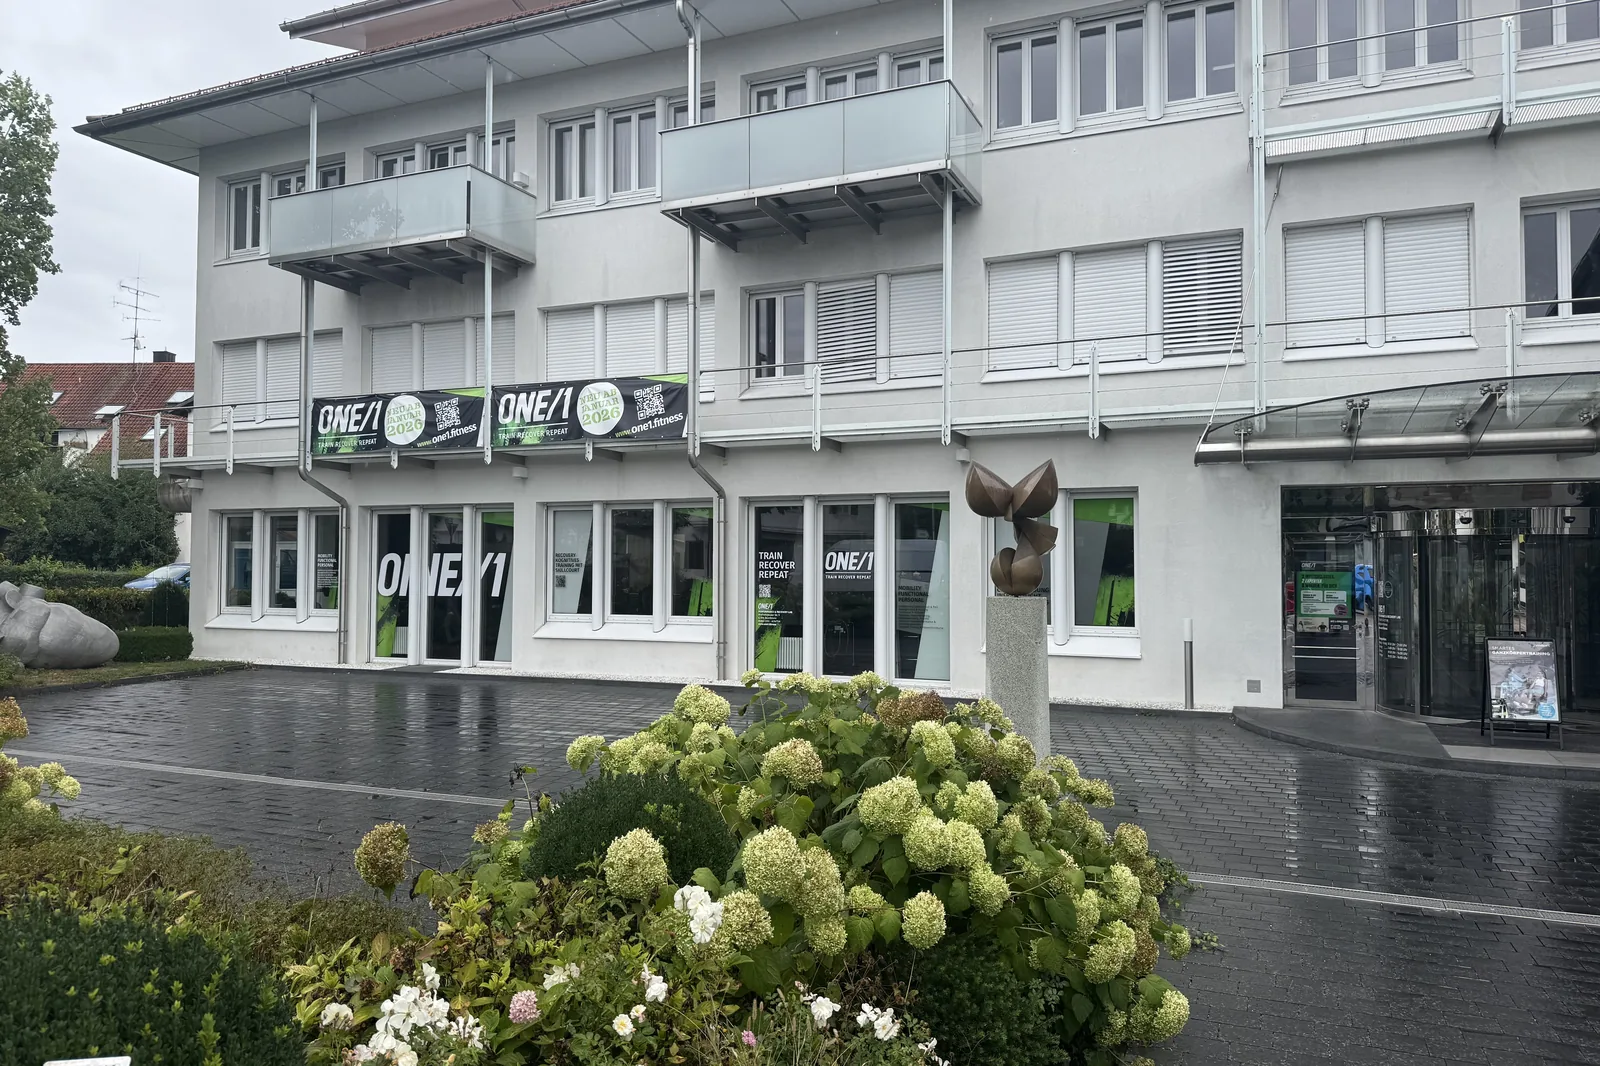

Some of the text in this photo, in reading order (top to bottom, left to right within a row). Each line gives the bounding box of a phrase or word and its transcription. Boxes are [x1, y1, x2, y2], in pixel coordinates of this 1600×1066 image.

[580, 388, 617, 405] NEU AB
[387, 402, 422, 418] NEU AB
[498, 387, 573, 424] ONE/1
[582, 397, 620, 413] JANUAR
[318, 400, 383, 434] ONE/1
[387, 410, 422, 424] JANUAR
[582, 407, 621, 426] 2026
[387, 419, 423, 436] 2026
[614, 412, 684, 438] www.one1.fitness
[416, 423, 478, 448] www.one1.fitness
[498, 428, 569, 440] TRAIN RECOVER REPEAT
[335, 440, 358, 448] RECOVER
[358, 438, 377, 446] REPEAT
[759, 552, 783, 560] TRAIN
[825, 551, 874, 571] ONE/1
[759, 561, 796, 569] RECOVER
[759, 571, 789, 579] REPEAT
